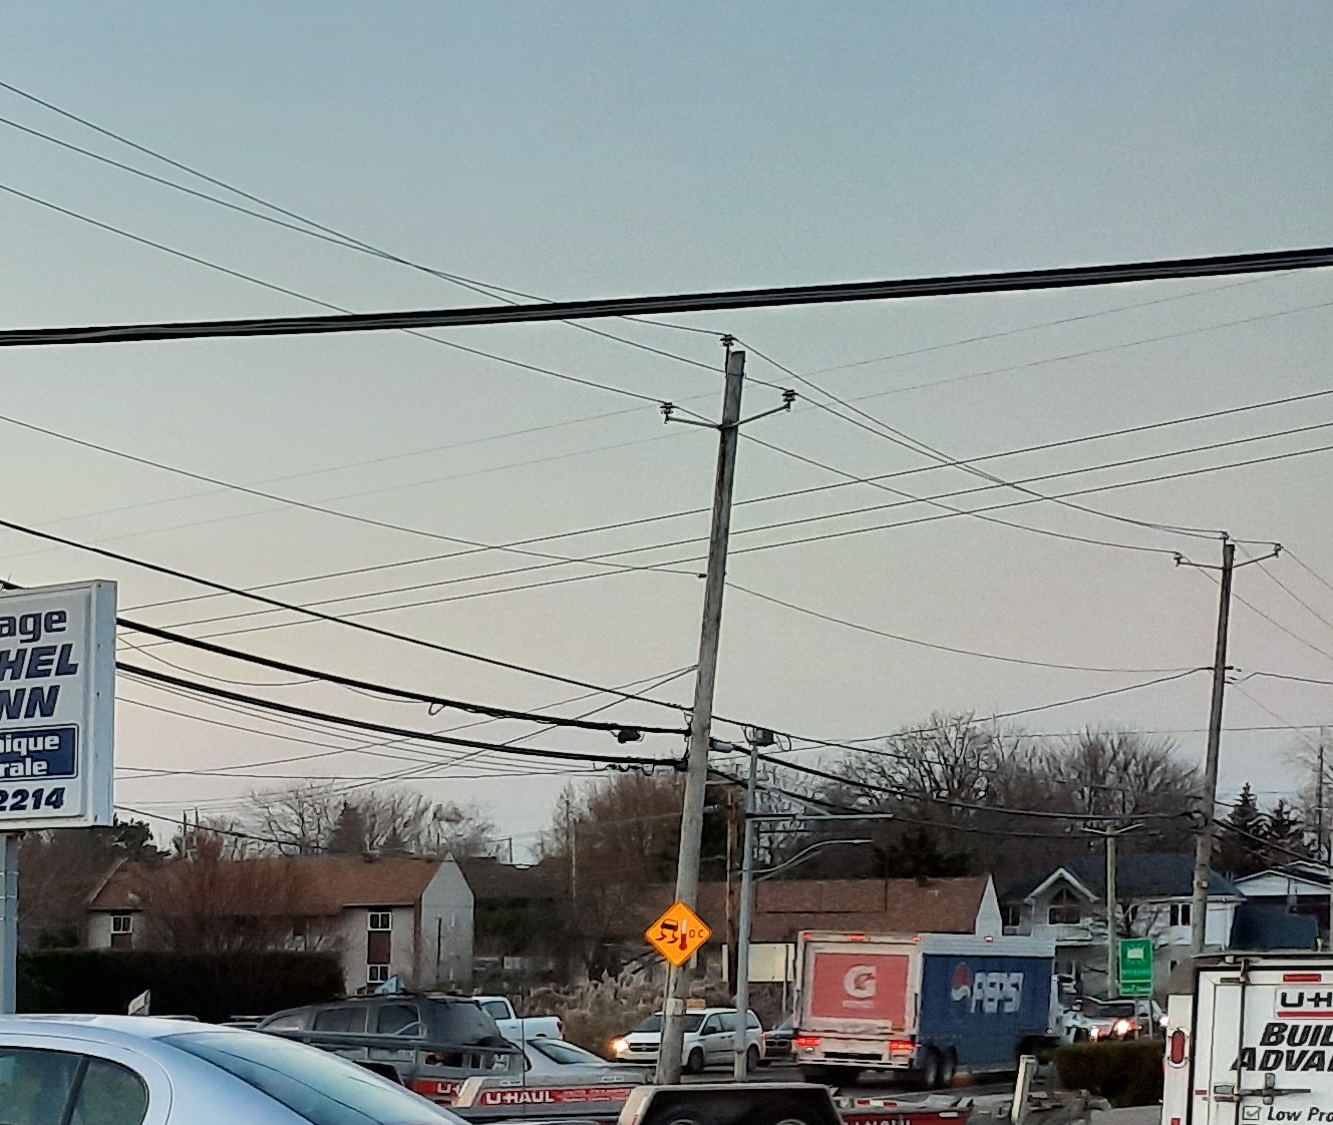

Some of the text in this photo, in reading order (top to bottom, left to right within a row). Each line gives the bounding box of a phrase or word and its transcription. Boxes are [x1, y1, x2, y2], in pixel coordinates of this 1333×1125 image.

[843, 964, 877, 999] G
[485, 1090, 555, 1105] U-HAUL
[1267, 1106, 1303, 1121] Low
